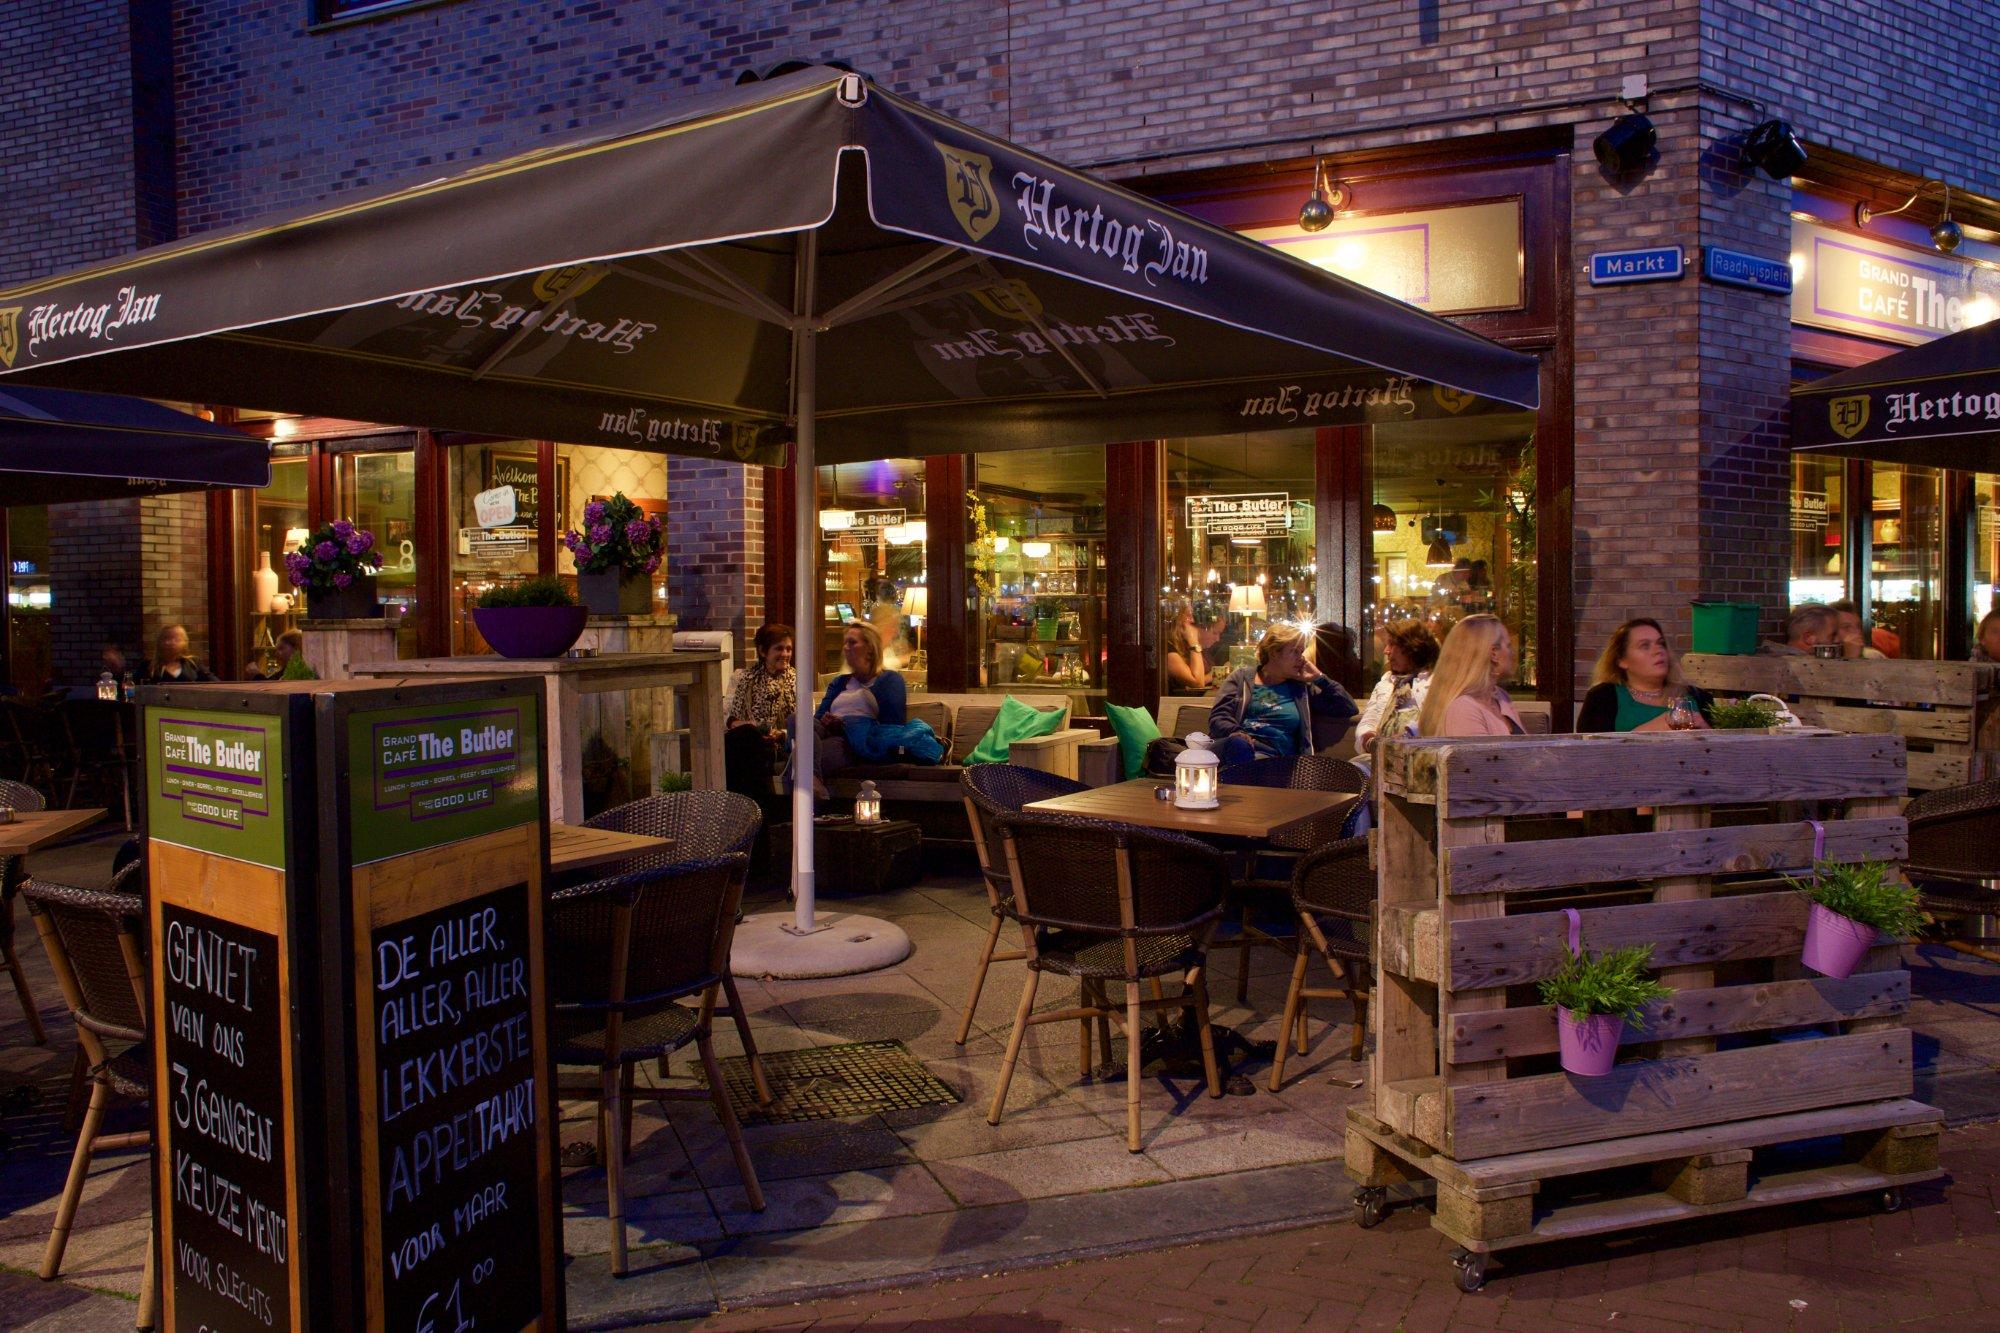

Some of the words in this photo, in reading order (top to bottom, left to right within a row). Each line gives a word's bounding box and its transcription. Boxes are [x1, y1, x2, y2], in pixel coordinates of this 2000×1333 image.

[1012, 171, 1145, 274] Hertog
[1144, 218, 1209, 287] Jan
[1607, 255, 1665, 274] Markt
[1715, 254, 1789, 284] Raadhuisplein
[1858, 260, 1909, 288] GRAND
[28, 302, 112, 358] Hertog
[105, 285, 161, 341] Jan
[1858, 292, 1909, 320] CAFÉ
[1912, 276, 1963, 333] The
[1885, 391, 2000, 433] Hertog
[868, 513, 903, 526] Butler
[1214, 501, 1238, 513] The
[1241, 499, 1284, 513] Butler
[400, 540, 414, 573] 8
[164, 731, 186, 743] GRAND
[165, 744, 187, 760] CAFÉ
[186, 736, 212, 765] The
[216, 739, 261, 772] Butler
[382, 735, 417, 747] GRAND
[383, 745, 417, 765] CAFÉ
[418, 732, 454, 761] The
[460, 725, 514, 755] Butler
[197, 803, 220, 817] GOOD
[221, 807, 239, 821] LIFE
[434, 793, 465, 809] GOOD
[467, 788, 489, 802] LIFE
[167, 921, 257, 1012] GENIET
[377, 935, 420, 991] DE
[430, 907, 505, 968] ALLER,
[381, 979, 462, 1044] ALLER,
[464, 957, 527, 1012] ALLER
[171, 1001, 204, 1049] VAN
[213, 1022, 244, 1068] ONS
[384, 1011, 531, 1122] LEKKERSTE
[387, 1078, 534, 1213] APPELTAART
[176, 1149, 243, 1237] KEUZE
[246, 1194, 286, 1264] MENU
[391, 1222, 446, 1280] VOOR
[453, 1181, 509, 1237] MAAR
[179, 1238, 212, 1291] VOOR
[216, 1262, 273, 1326] SLECHTS
